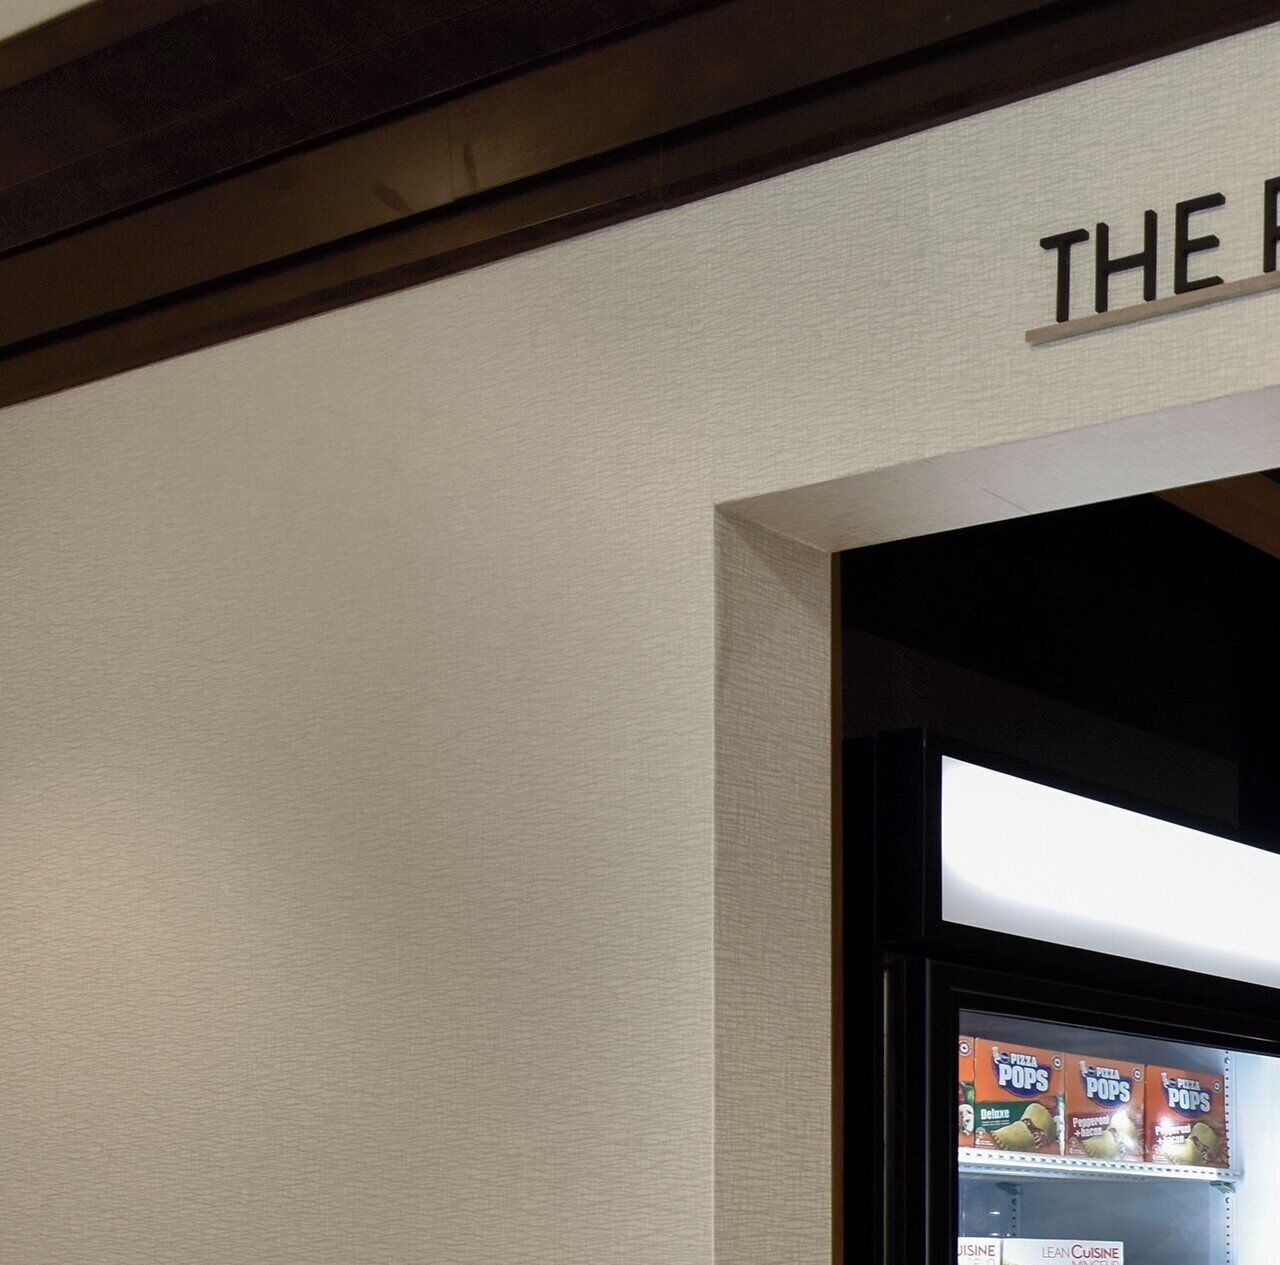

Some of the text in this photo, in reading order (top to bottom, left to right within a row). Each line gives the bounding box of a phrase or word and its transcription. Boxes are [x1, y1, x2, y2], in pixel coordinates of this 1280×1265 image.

[1039, 192, 1226, 324] THE
[1010, 1053, 1038, 1068] PIZZA
[998, 1063, 1049, 1092] POPS
[1096, 1067, 1120, 1080] PIZZA
[1086, 1077, 1130, 1102] POPS
[1177, 1078, 1200, 1089] PIZZA
[1168, 1088, 1211, 1113] POPS
[980, 1108, 1010, 1120] Deluxe
[1042, 1246, 1070, 1258] LEAN
